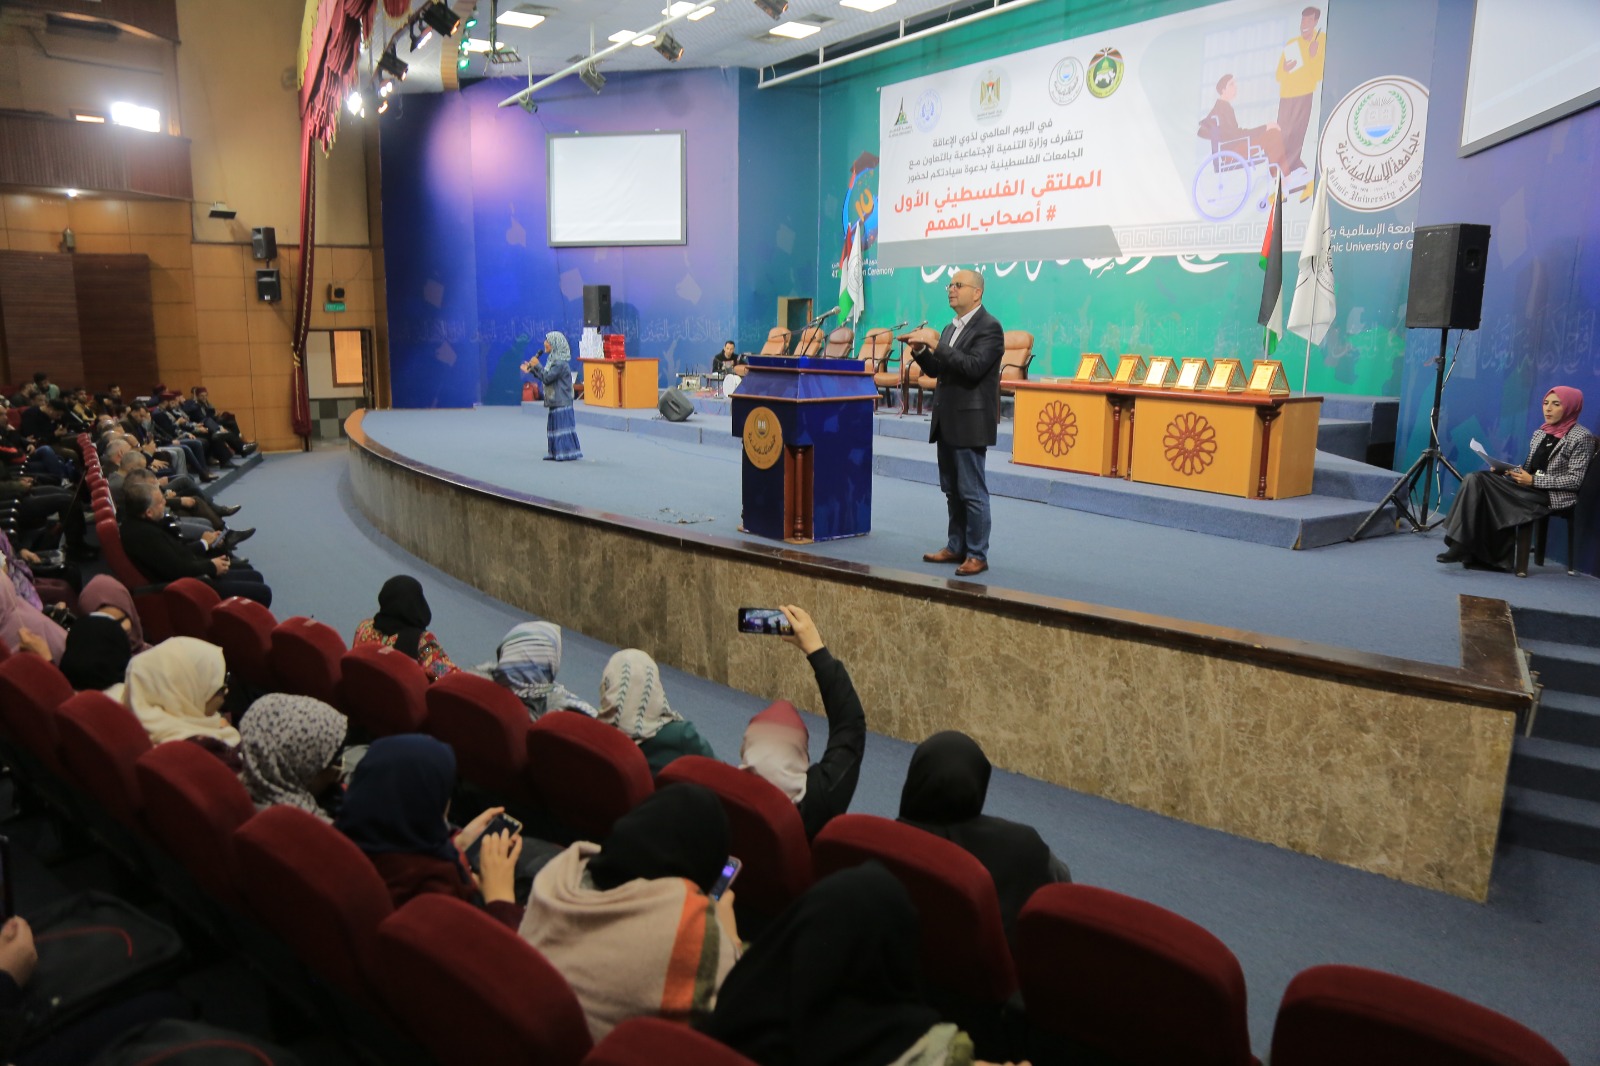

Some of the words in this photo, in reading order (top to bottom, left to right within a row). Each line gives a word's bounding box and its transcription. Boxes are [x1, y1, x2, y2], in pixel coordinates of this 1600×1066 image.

[1013, 121, 1035, 136] اليوم
[1038, 118, 1053, 133] في
[932, 135, 957, 148] الإعاقة
[958, 131, 978, 147] لذوي
[979, 125, 1011, 143] العالمي
[1050, 129, 1084, 145] تتشرف
[996, 139, 1027, 154] التنمية
[1029, 136, 1048, 149] وزارة
[922, 152, 952, 167] بالتعاون
[954, 144, 994, 160] الإجتماعية
[1043, 147, 1084, 162] الجامعات
[908, 159, 921, 170] مع
[964, 164, 988, 175] بدعوة
[990, 153, 1041, 171] الفلسطينية
[907, 170, 929, 184] لحضور
[930, 167, 962, 181] سيادتكم
[1031, 168, 1102, 199] الملتقى
[894, 189, 929, 213] الأول
[934, 179, 1025, 213] الفلسطيني
[1340, 223, 1385, 238] الإسلامية
[1388, 221, 1415, 234] امعة
[1345, 241, 1391, 253] University
[1393, 240, 1404, 250] of
[867, 267, 895, 277] Ceremony
